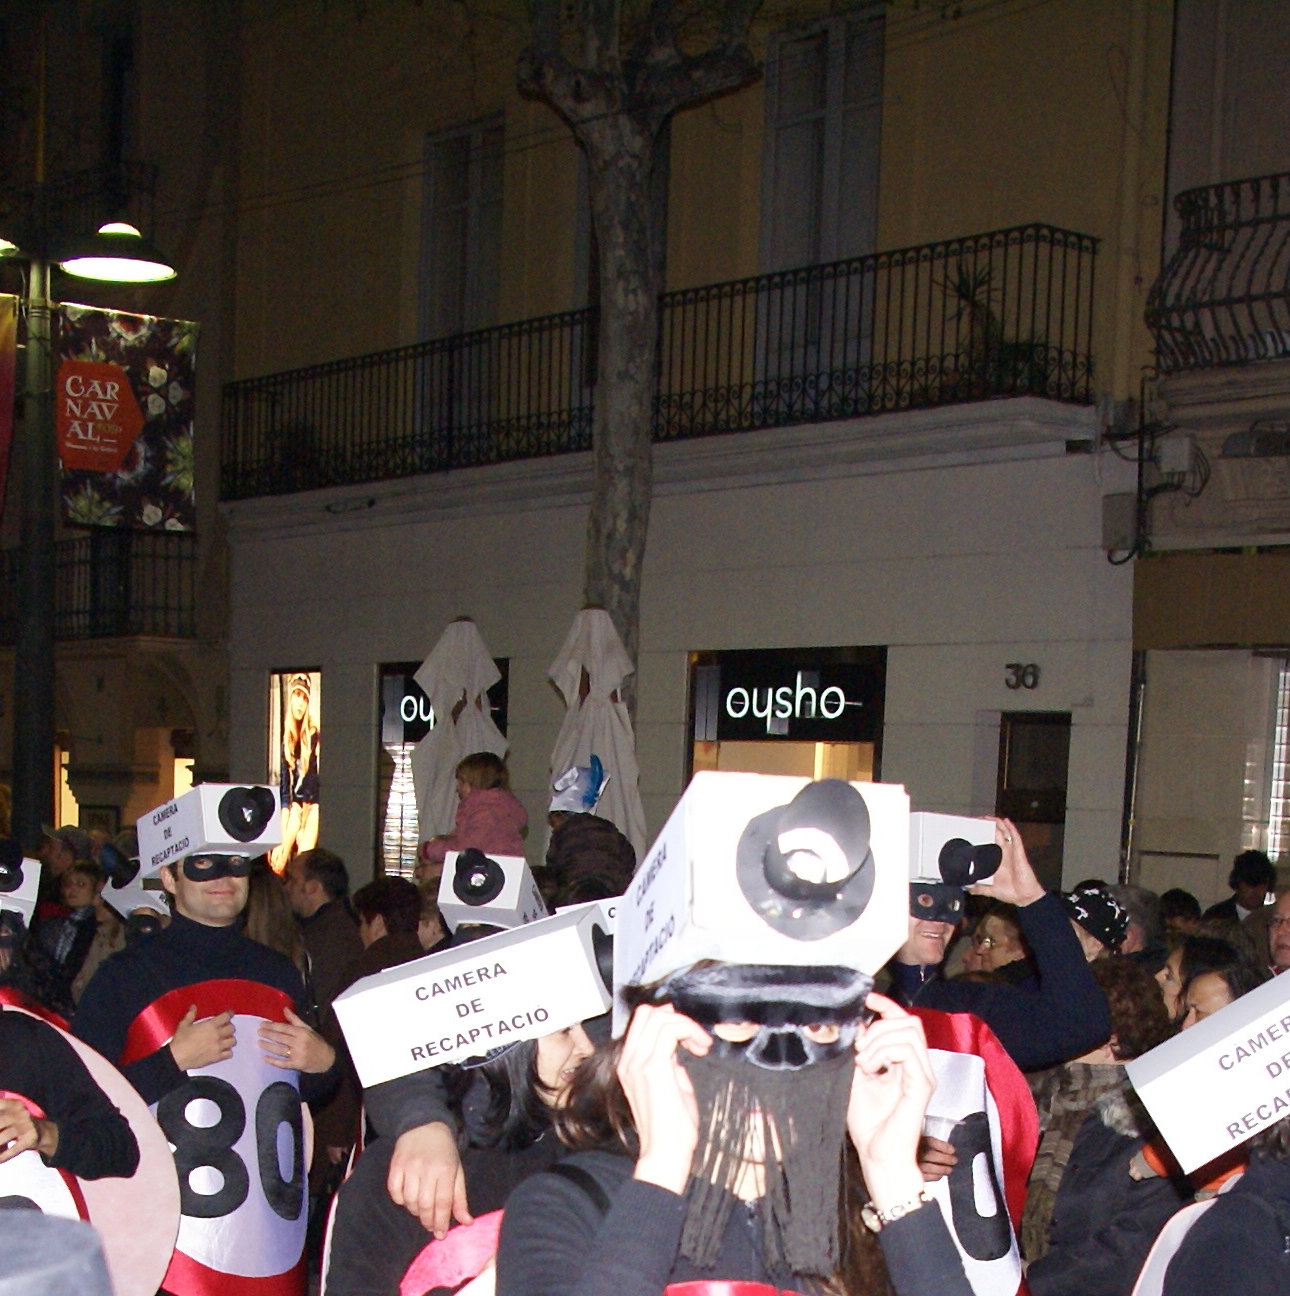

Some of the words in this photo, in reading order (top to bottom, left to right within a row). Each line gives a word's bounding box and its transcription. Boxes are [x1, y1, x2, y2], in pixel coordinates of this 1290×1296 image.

[65, 375, 120, 401] CAR
[65, 398, 120, 421] NAV
[66, 420, 100, 443] AL
[400, 695, 435, 731] oy
[726, 670, 846, 735] oysho
[455, 998, 485, 1018] DE
[156, 1075, 304, 1221] 80
